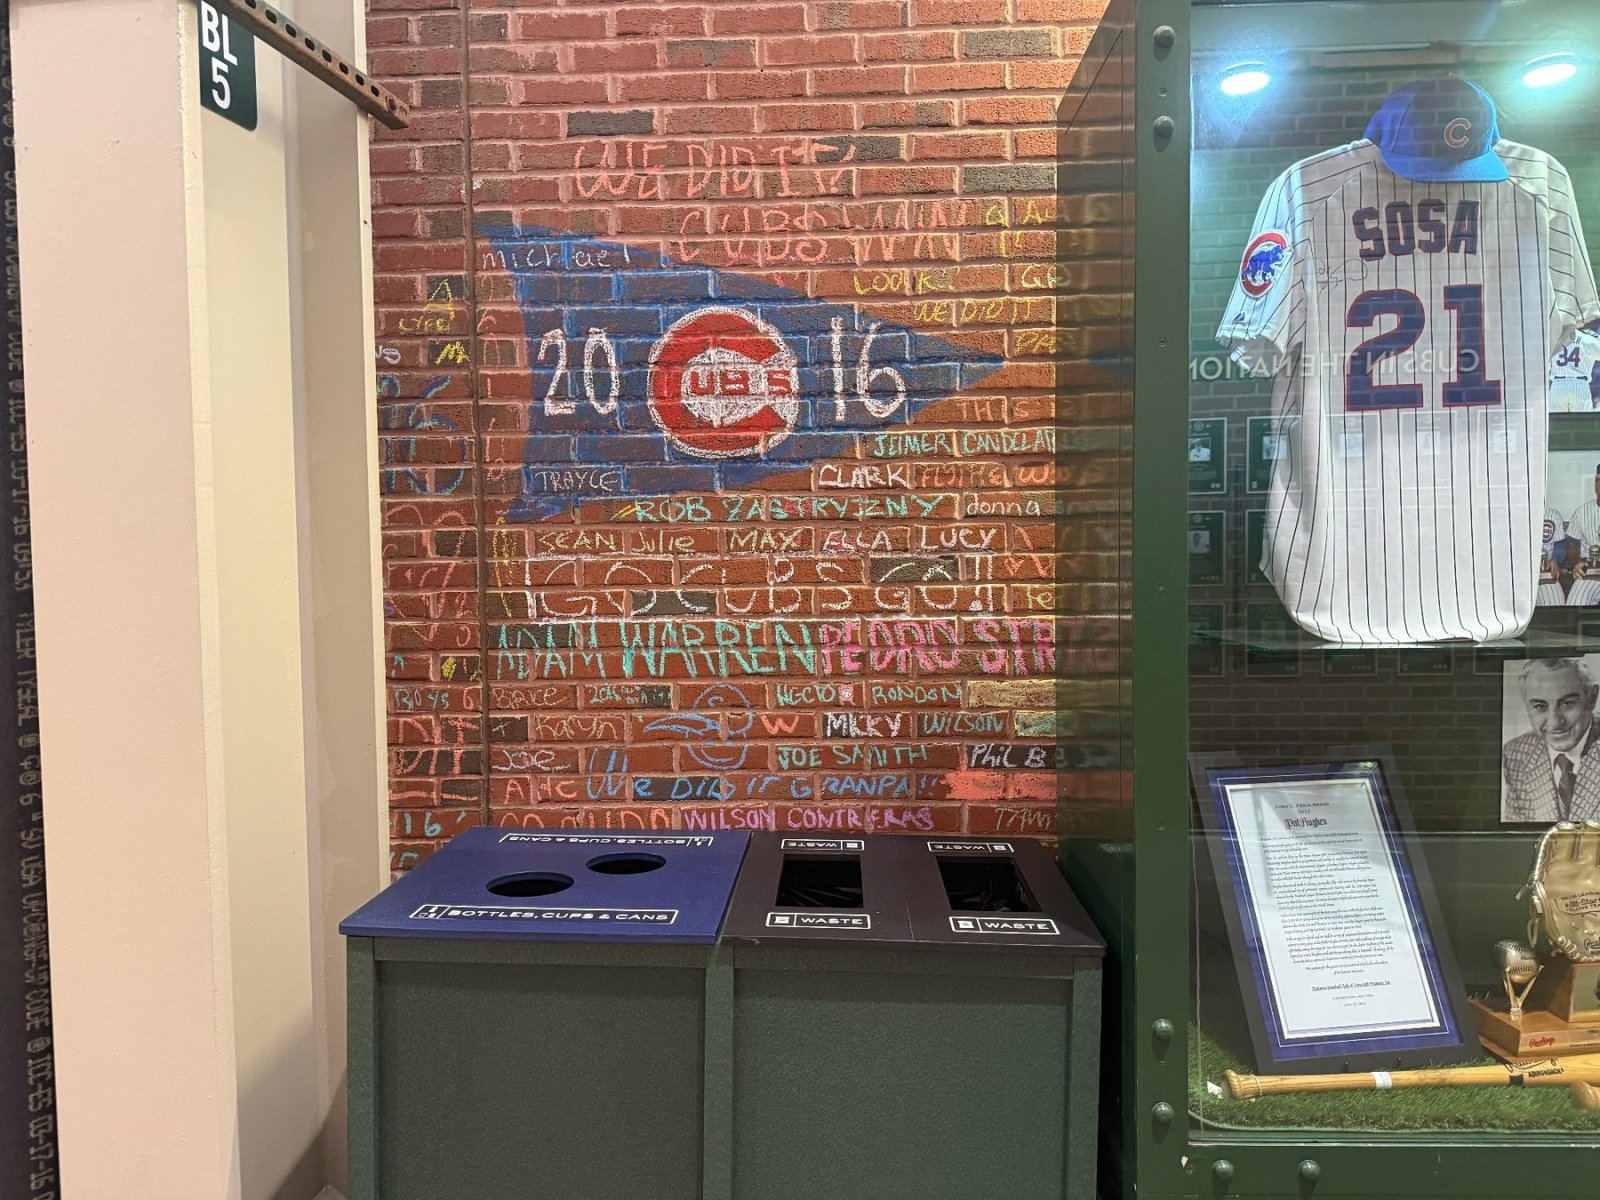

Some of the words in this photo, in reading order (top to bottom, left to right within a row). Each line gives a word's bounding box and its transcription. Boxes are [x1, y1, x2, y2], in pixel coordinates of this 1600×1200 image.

[201, 3, 238, 65] BL
[211, 57, 232, 109] 5
[1444, 118, 1471, 148] C
[574, 143, 667, 199] WE
[686, 143, 756, 198] DID
[679, 205, 827, 263] CUBS
[1352, 200, 1480, 261] SOSA
[1346, 284, 1501, 411] 21
[538, 328, 620, 417] 20
[829, 316, 906, 420] 16
[818, 465, 910, 489] CLARK
[634, 496, 713, 522] ROB
[966, 493, 1041, 516] donna
[538, 530, 617, 552] SEAN
[729, 528, 804, 551] MAX
[822, 530, 893, 552] ELLA
[921, 526, 997, 550] LUCY
[618, 619, 818, 679] WARREN
[818, 620, 962, 676] PEDRO
[777, 745, 822, 770] JOE
[684, 806, 778, 832] WILSON
[615, 913, 669, 921] CANS
[801, 916, 863, 926] WASTE
[984, 921, 1049, 931] WASTE
